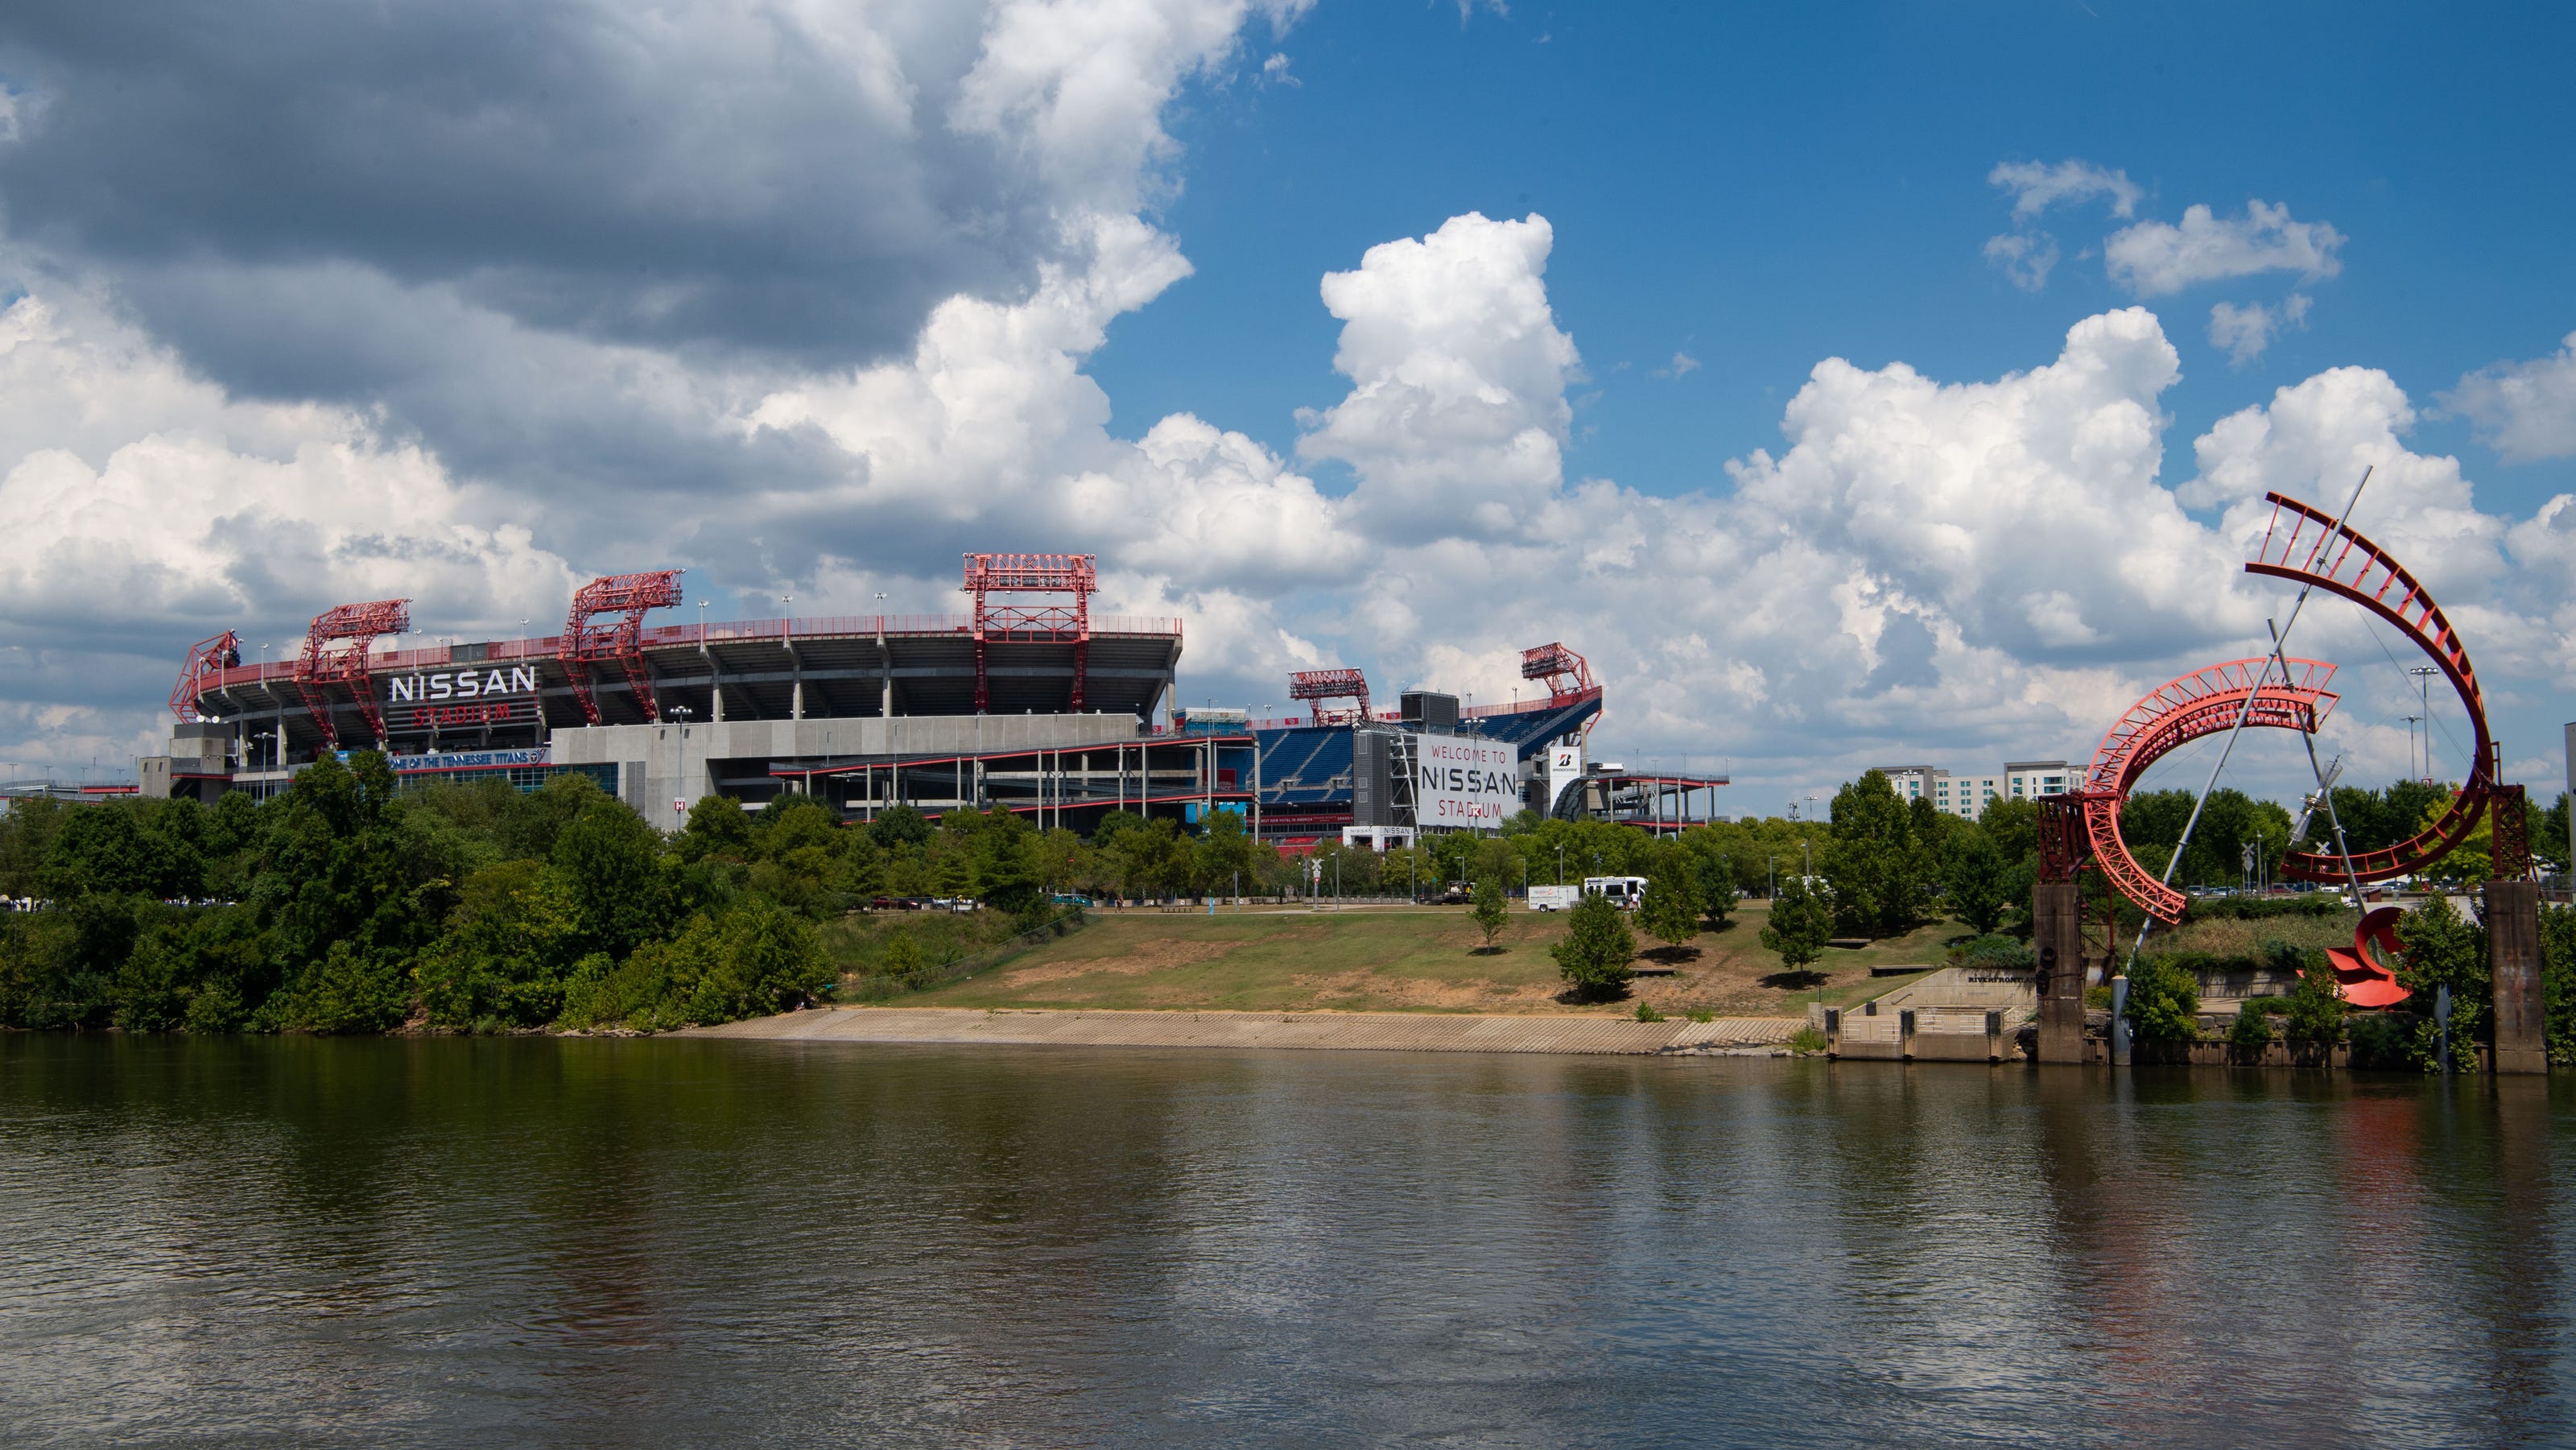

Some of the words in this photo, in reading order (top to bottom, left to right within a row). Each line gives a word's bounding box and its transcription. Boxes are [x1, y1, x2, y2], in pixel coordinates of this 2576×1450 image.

[391, 666, 535, 702] NISSAN
[413, 702, 510, 727] STADIUM
[390, 758, 407, 770] OME
[410, 758, 421, 769] OF
[423, 757, 439, 768] THE
[442, 754, 492, 767] TENNESSEE
[494, 751, 529, 764] TITANS
[1432, 745, 1487, 762] WELCOME
[1492, 751, 1506, 763] TO
[1422, 766, 1516, 795] NISSAN
[676, 802, 683, 810] H
[1439, 799, 1502, 819] STADUM
[1472, 808, 1480, 816] K
